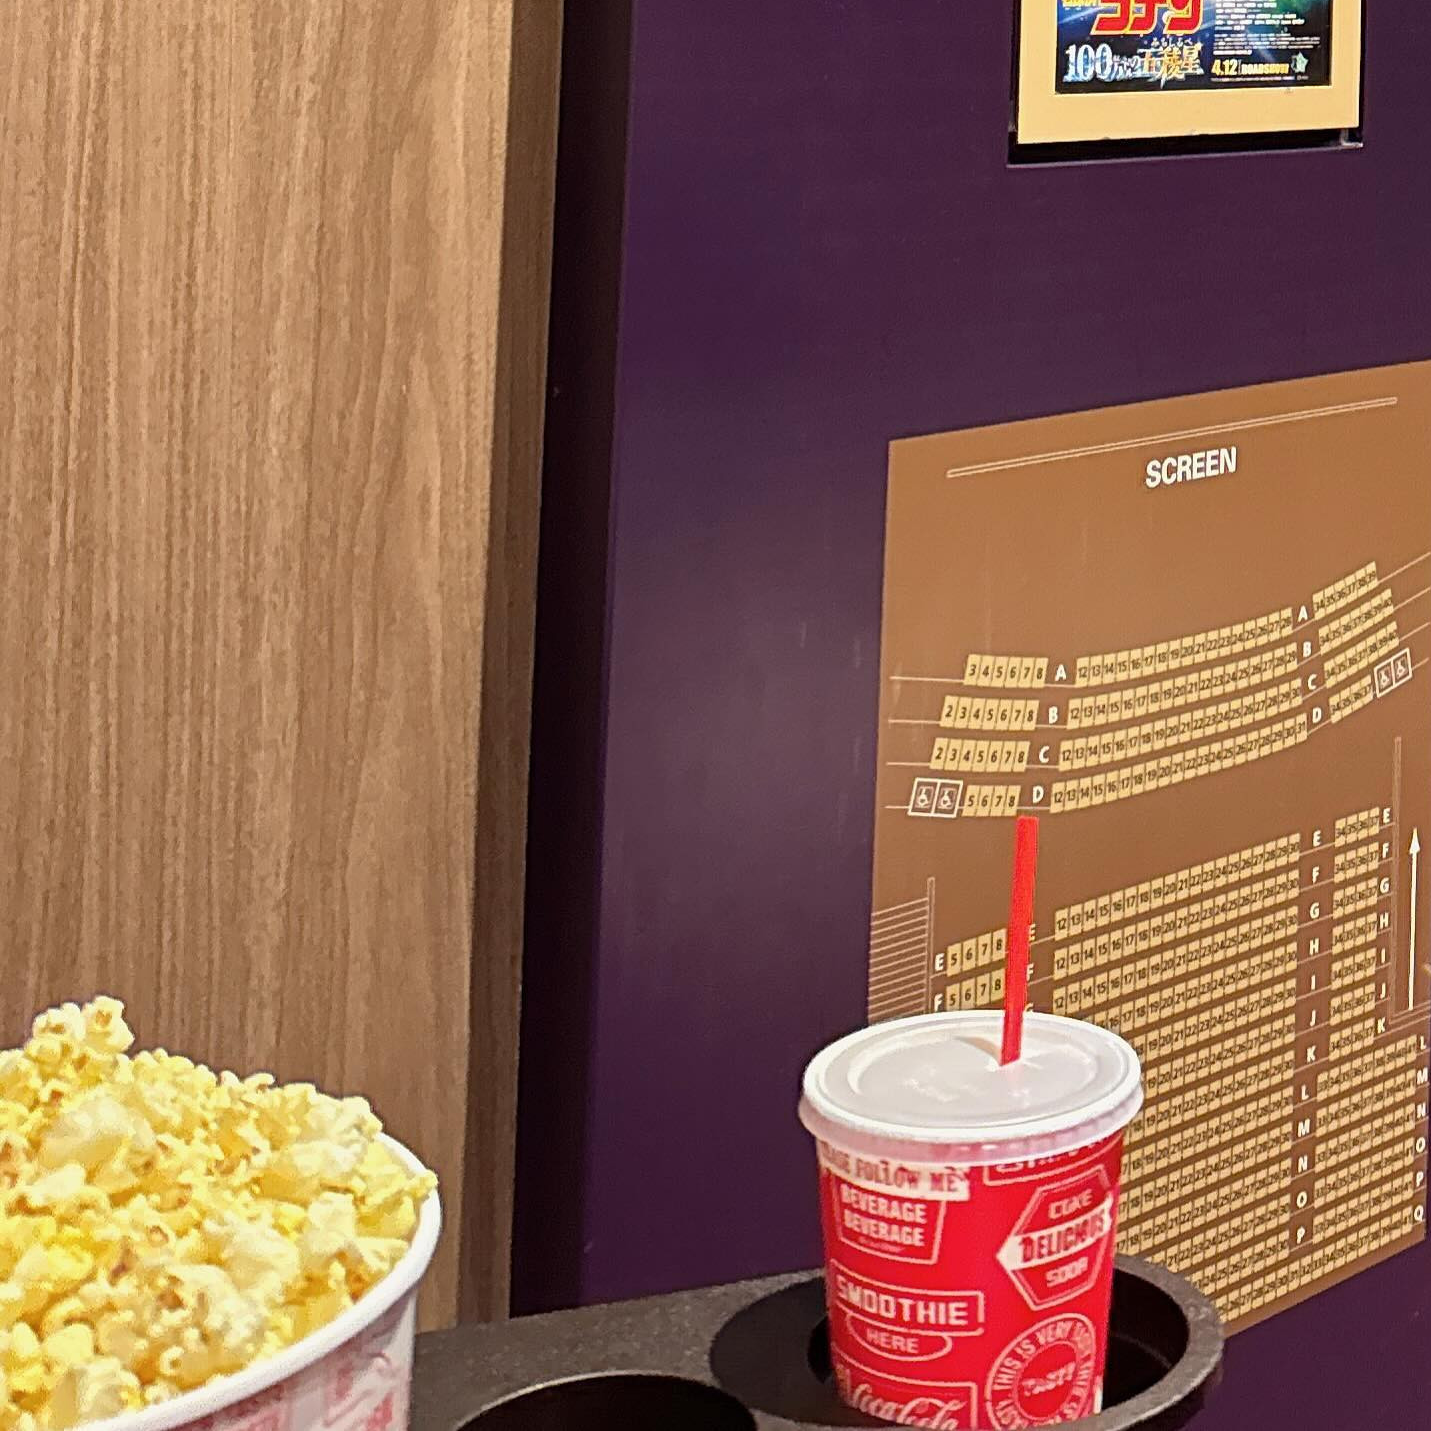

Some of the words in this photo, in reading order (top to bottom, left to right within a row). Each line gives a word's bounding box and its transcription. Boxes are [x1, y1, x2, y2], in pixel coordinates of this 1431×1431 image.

[1211, 59, 1239, 76] 4.12
[1145, 446, 1238, 489] SCREEN
[1055, 664, 1067, 682] A
[1298, 605, 1308, 622] A
[1048, 706, 1058, 724] B
[1303, 641, 1312, 658] B
[1038, 746, 1050, 763] C
[1307, 674, 1317, 690] C
[1032, 785, 1044, 803] D
[1312, 707, 1322, 723] D
[935, 953, 944, 971] E
[1313, 830, 1321, 847] E
[1383, 808, 1391, 823] E
[1309, 903, 1320, 919] G
[1379, 877, 1390, 893] G
[934, 993, 943, 1011] F
[1026, 963, 1034, 982] F
[1312, 866, 1320, 883] F
[1382, 842, 1389, 858] F
[1309, 938, 1319, 955] H
[1379, 912, 1389, 929] H
[1311, 975, 1316, 990] I
[1381, 949, 1386, 963] I
[1310, 1010, 1316, 1027] J
[1380, 983, 1386, 999] J
[1306, 1046, 1316, 1062] K
[1377, 1017, 1386, 1033] K
[1301, 1085, 1309, 1100] L
[1420, 1036, 1427, 1050] L
[1297, 1119, 1310, 1137] M
[1416, 1067, 1428, 1084] M
[1298, 1155, 1308, 1173] N
[1417, 1102, 1426, 1118] N
[1296, 1191, 1307, 1208] O
[1415, 1137, 1426, 1153] O
[840, 1183, 927, 1224] BEVERAGE
[844, 1209, 925, 1247] BEVERAGE
[1296, 1227, 1306, 1243] P
[1416, 1171, 1424, 1187] P
[1413, 1205, 1424, 1222] Q
[836, 1274, 969, 1326] SMOOTHIE
[866, 1327, 919, 1354] HERE
